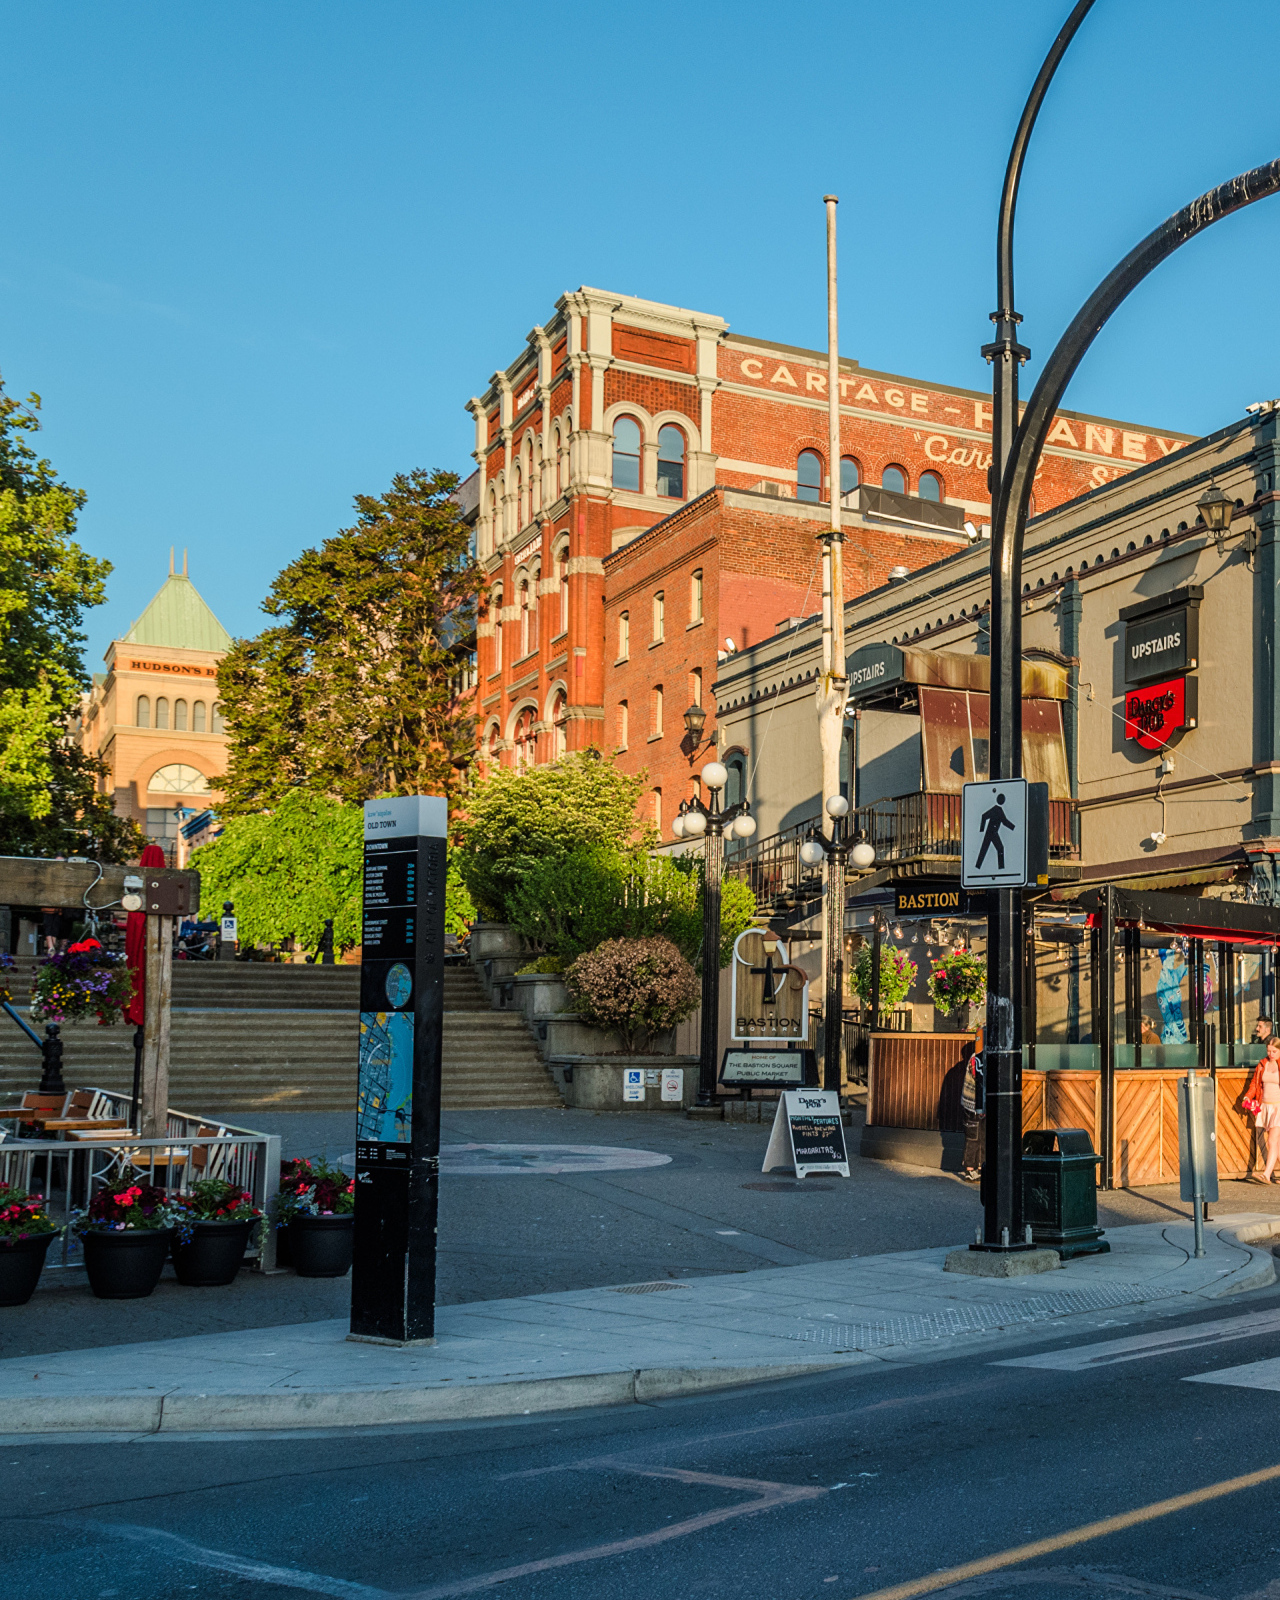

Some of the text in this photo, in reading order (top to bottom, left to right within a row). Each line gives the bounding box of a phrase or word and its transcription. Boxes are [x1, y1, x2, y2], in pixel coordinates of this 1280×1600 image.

[740, 358, 929, 414] CARTAGE
[975, 402, 1184, 461] HANEY
[1131, 632, 1181, 660] UPSTAIRS
[131, 661, 202, 675] HUDSON'S
[1139, 712, 1165, 738] PUB
[368, 820, 397, 830] OLD TOWN
[898, 892, 960, 910] BASTION
[736, 1018, 801, 1027] BASTION
[813, 1117, 839, 1125] FEATURES
[796, 1146, 835, 1155] MARGARITAS
